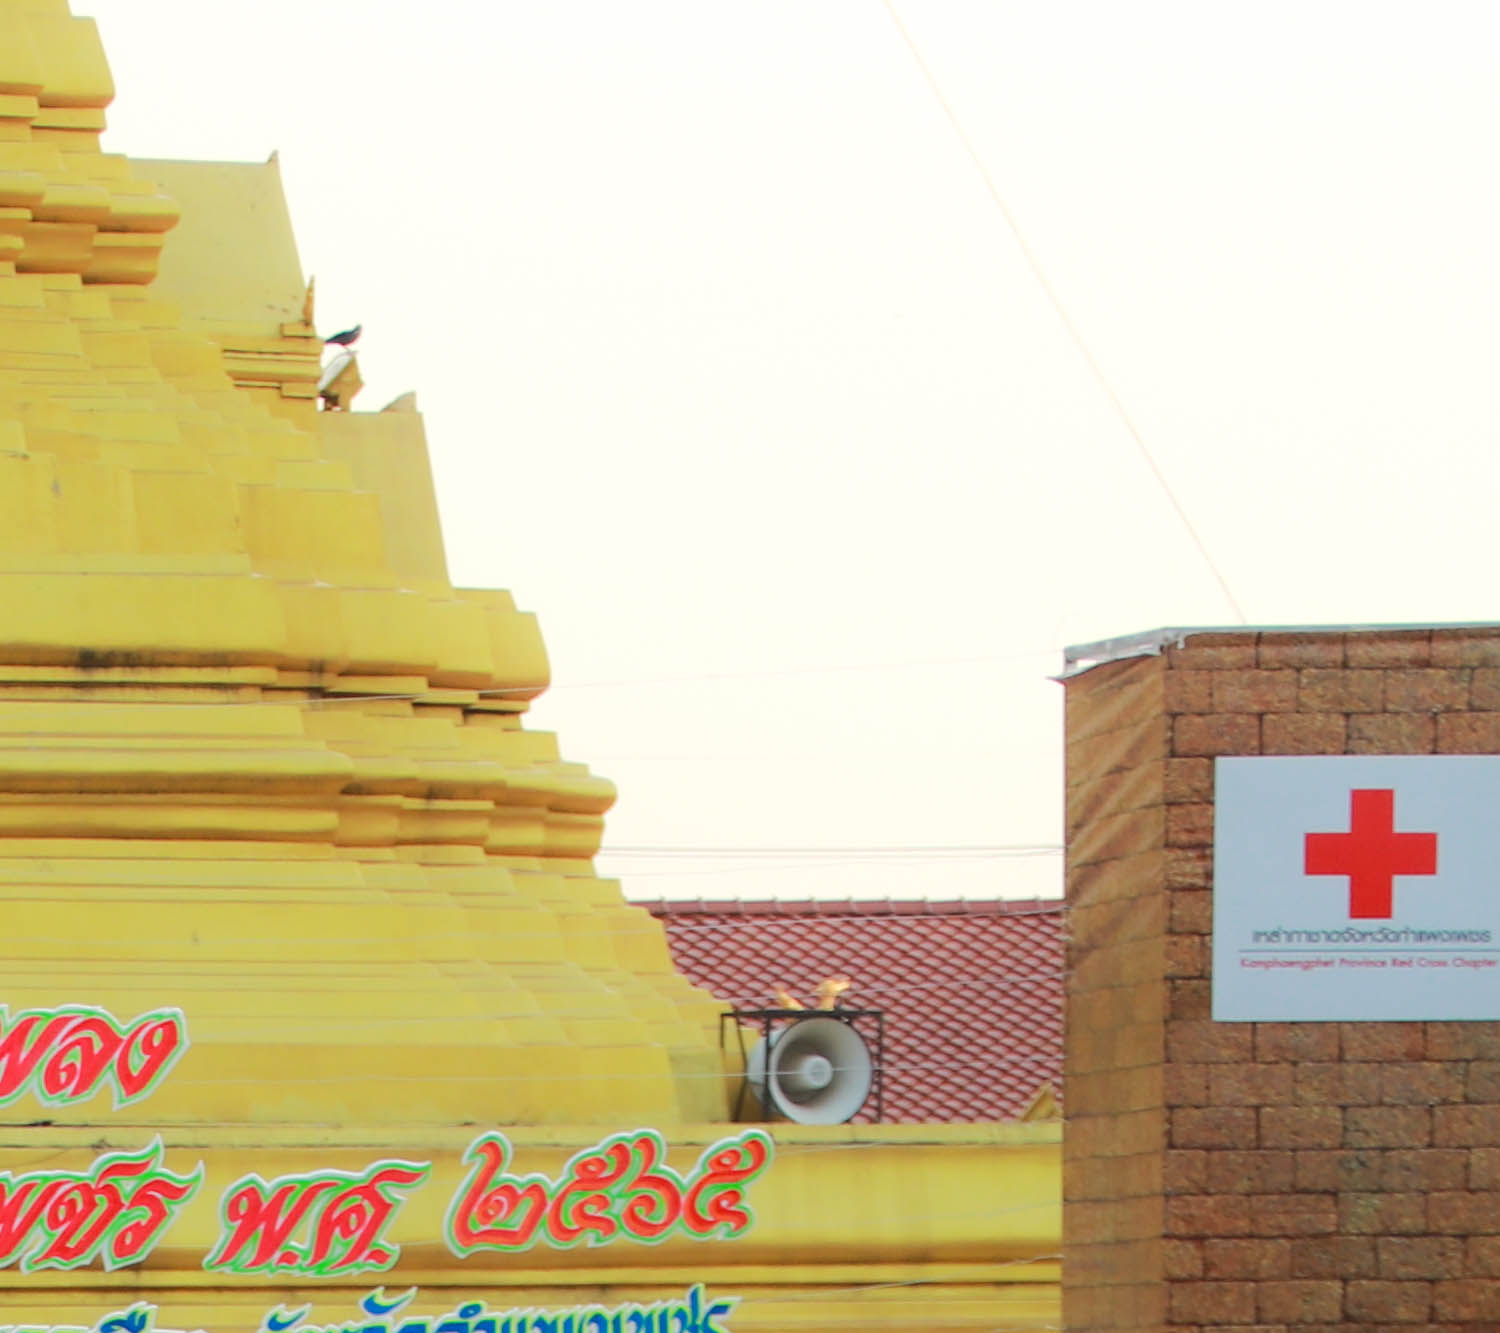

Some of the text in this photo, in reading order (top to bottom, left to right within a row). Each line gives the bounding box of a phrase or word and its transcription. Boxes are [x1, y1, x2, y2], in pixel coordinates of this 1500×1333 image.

[1339, 957, 1387, 969] Province
[1391, 957, 1414, 969] Red
[1418, 957, 1449, 969] Cross
[1452, 957, 1499, 971] Chapter
[447, 1130, 772, 1256] ๒๕๖๕
